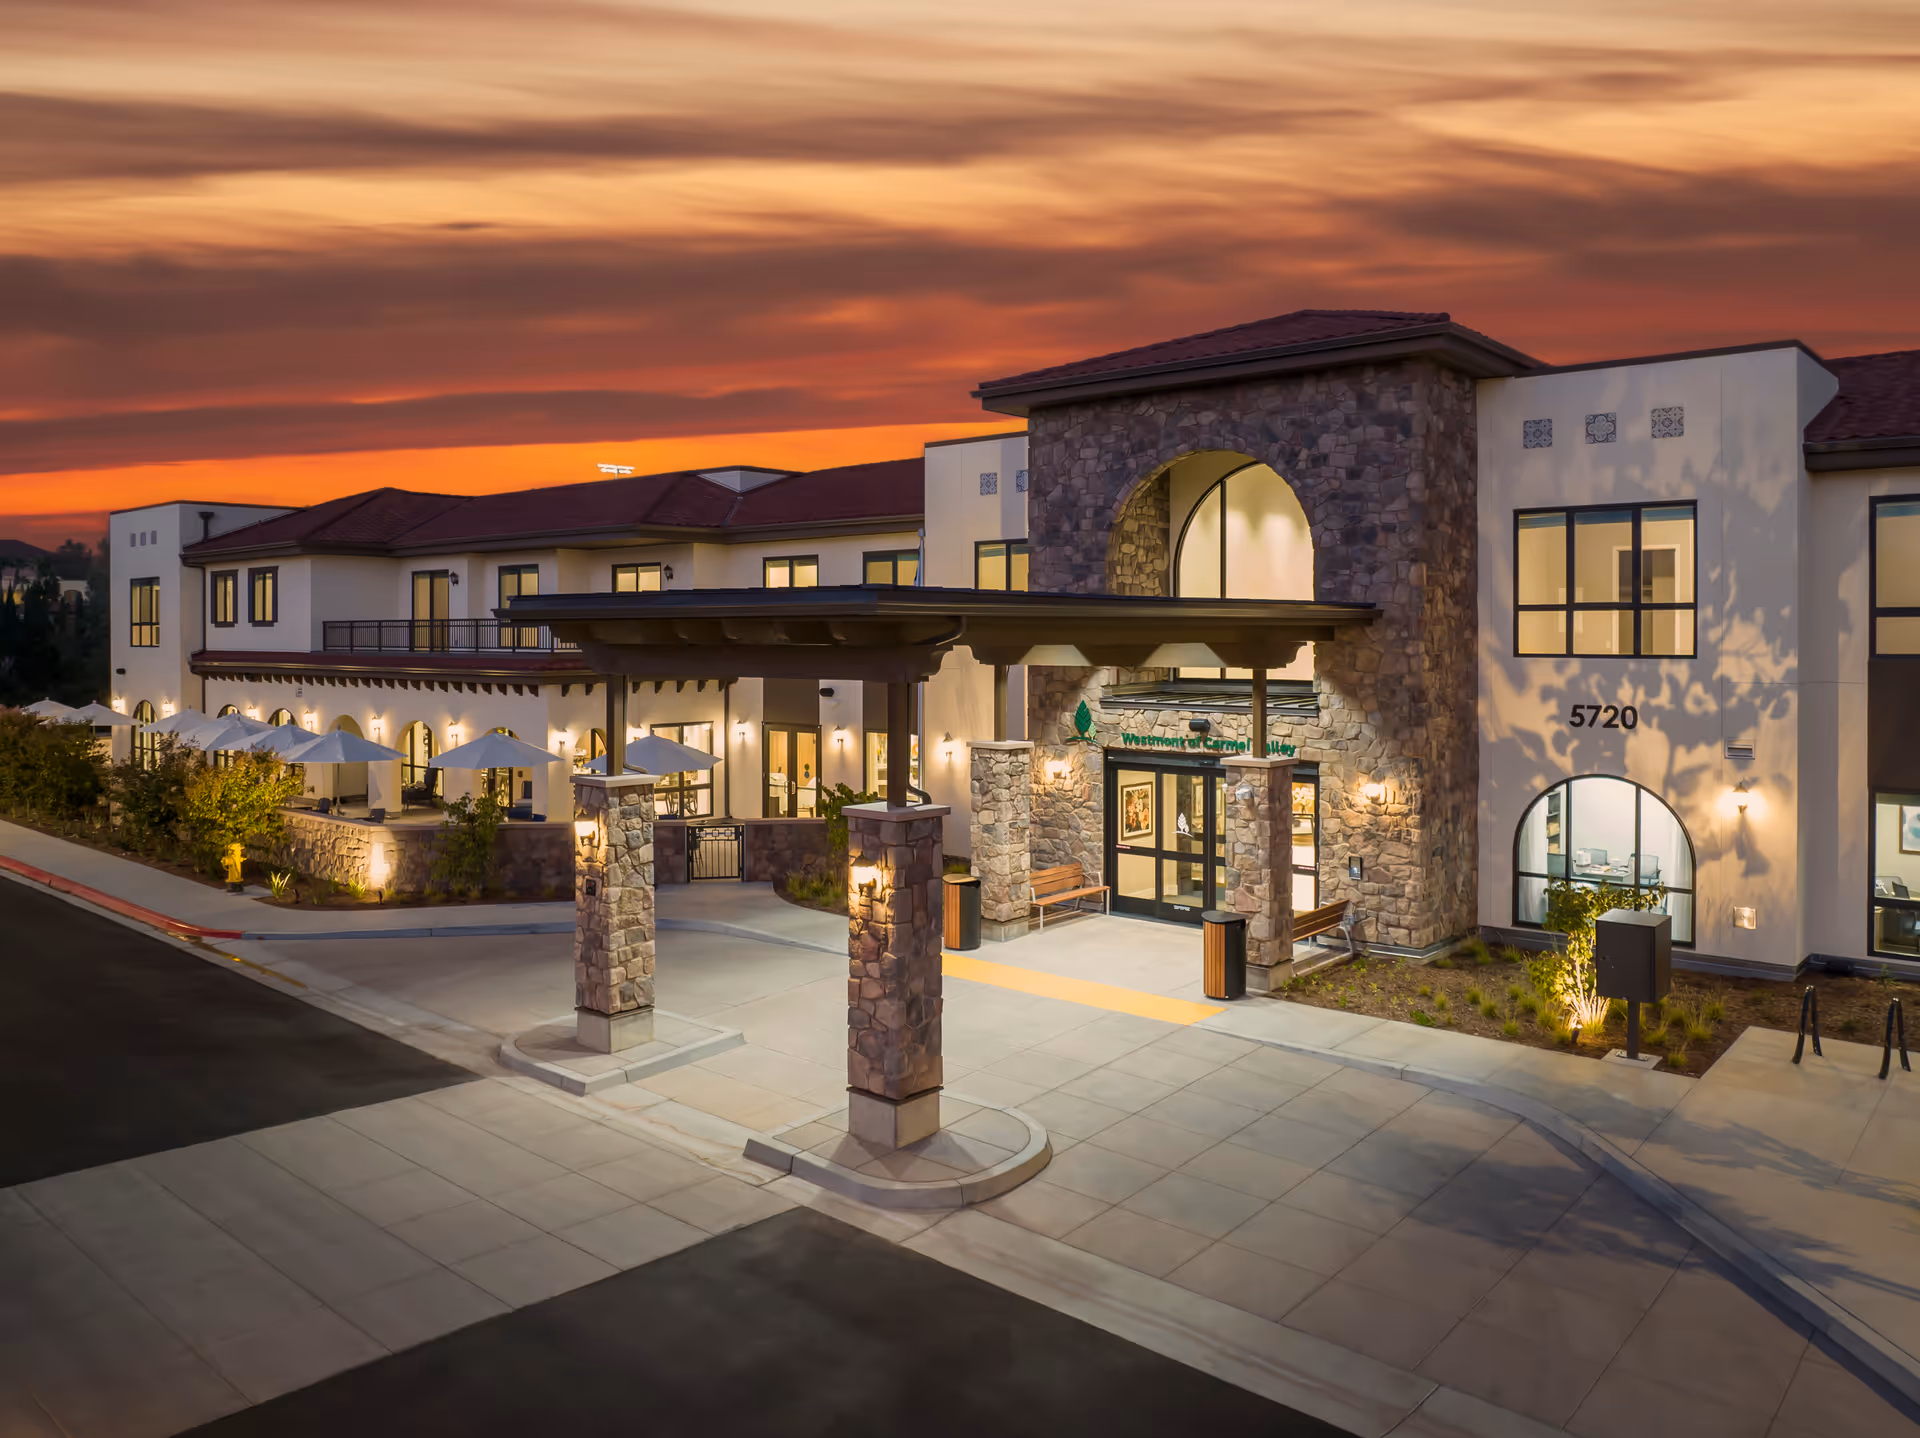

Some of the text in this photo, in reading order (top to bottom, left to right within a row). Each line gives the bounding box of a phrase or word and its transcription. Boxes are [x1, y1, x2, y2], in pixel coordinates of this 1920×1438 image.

[1569, 705, 1638, 729] 5720
[1121, 732, 1295, 757] Westmont of Carmel alley
